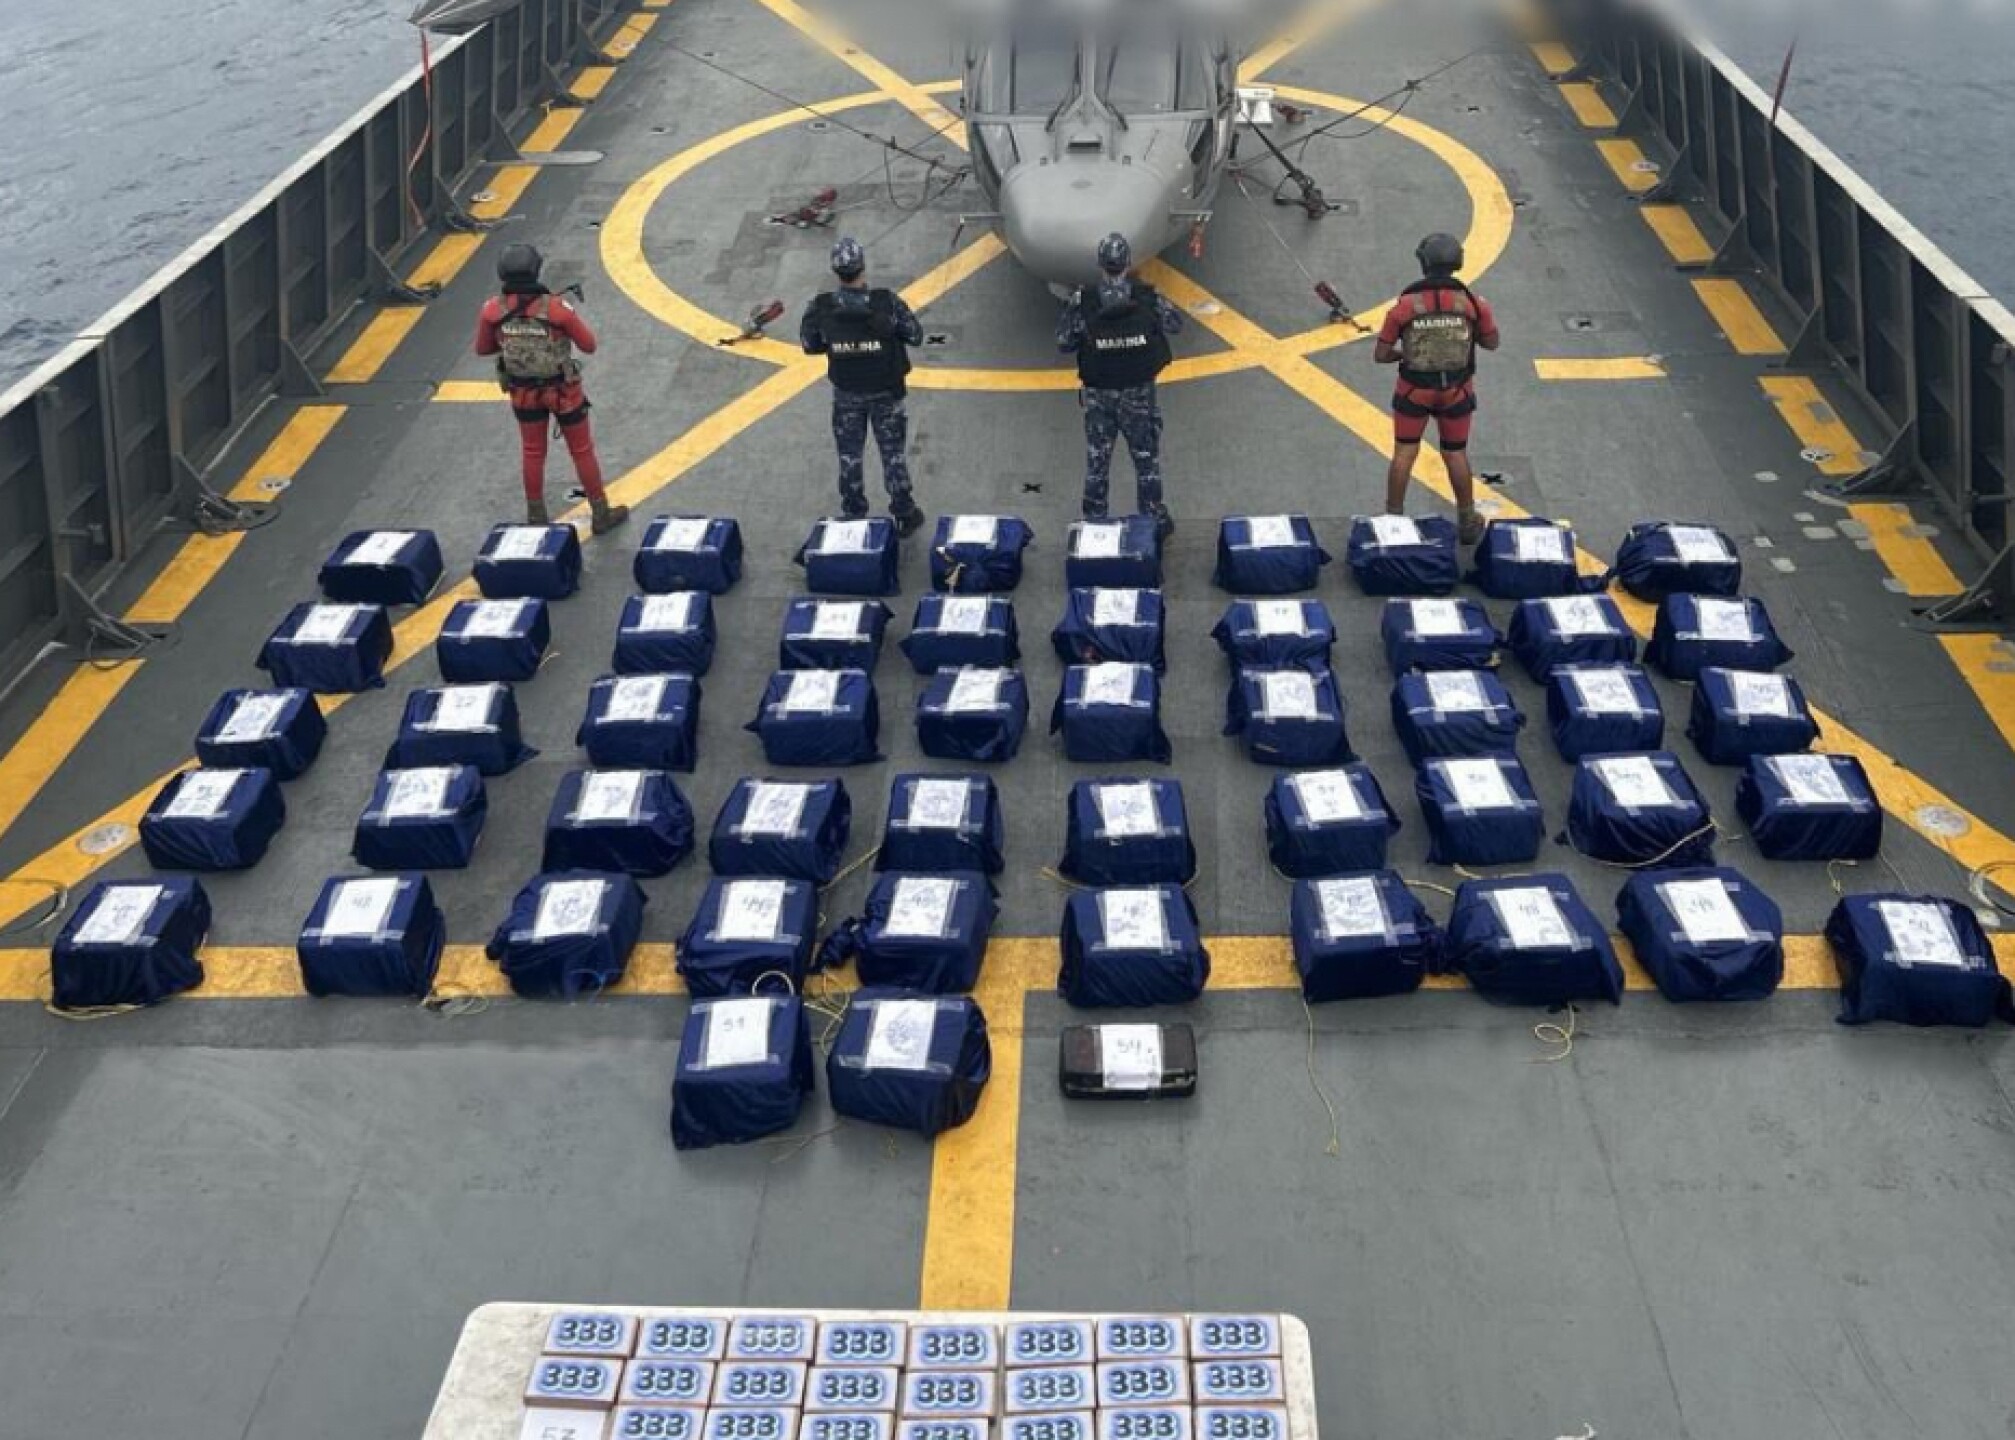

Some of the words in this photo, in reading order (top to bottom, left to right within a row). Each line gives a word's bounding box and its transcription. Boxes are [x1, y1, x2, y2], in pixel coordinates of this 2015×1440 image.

[1413, 317, 1462, 330] MARINA
[1096, 334, 1147, 349] MARINA
[558, 1319, 616, 1342] 333
[652, 1322, 708, 1347] 333
[743, 1324, 796, 1348] 333
[831, 1329, 888, 1354] 333
[1018, 1329, 1075, 1353] 333
[1110, 1322, 1166, 1347] 333
[1205, 1322, 1262, 1346] 333
[925, 1332, 980, 1357] 333
[542, 1364, 601, 1389] 333
[637, 1367, 695, 1391] 333
[729, 1370, 788, 1395] 333
[821, 1374, 880, 1398] 333
[1020, 1374, 1077, 1400] 333
[1110, 1367, 1168, 1394] 333
[1208, 1365, 1267, 1389] 333
[918, 1378, 976, 1404] 333
[624, 1411, 684, 1437] 333
[717, 1413, 776, 1437] 333
[814, 1420, 872, 1440] 333
[1016, 1420, 1075, 1440] 333
[1114, 1413, 1174, 1437] 333
[1212, 1413, 1270, 1438] 333
